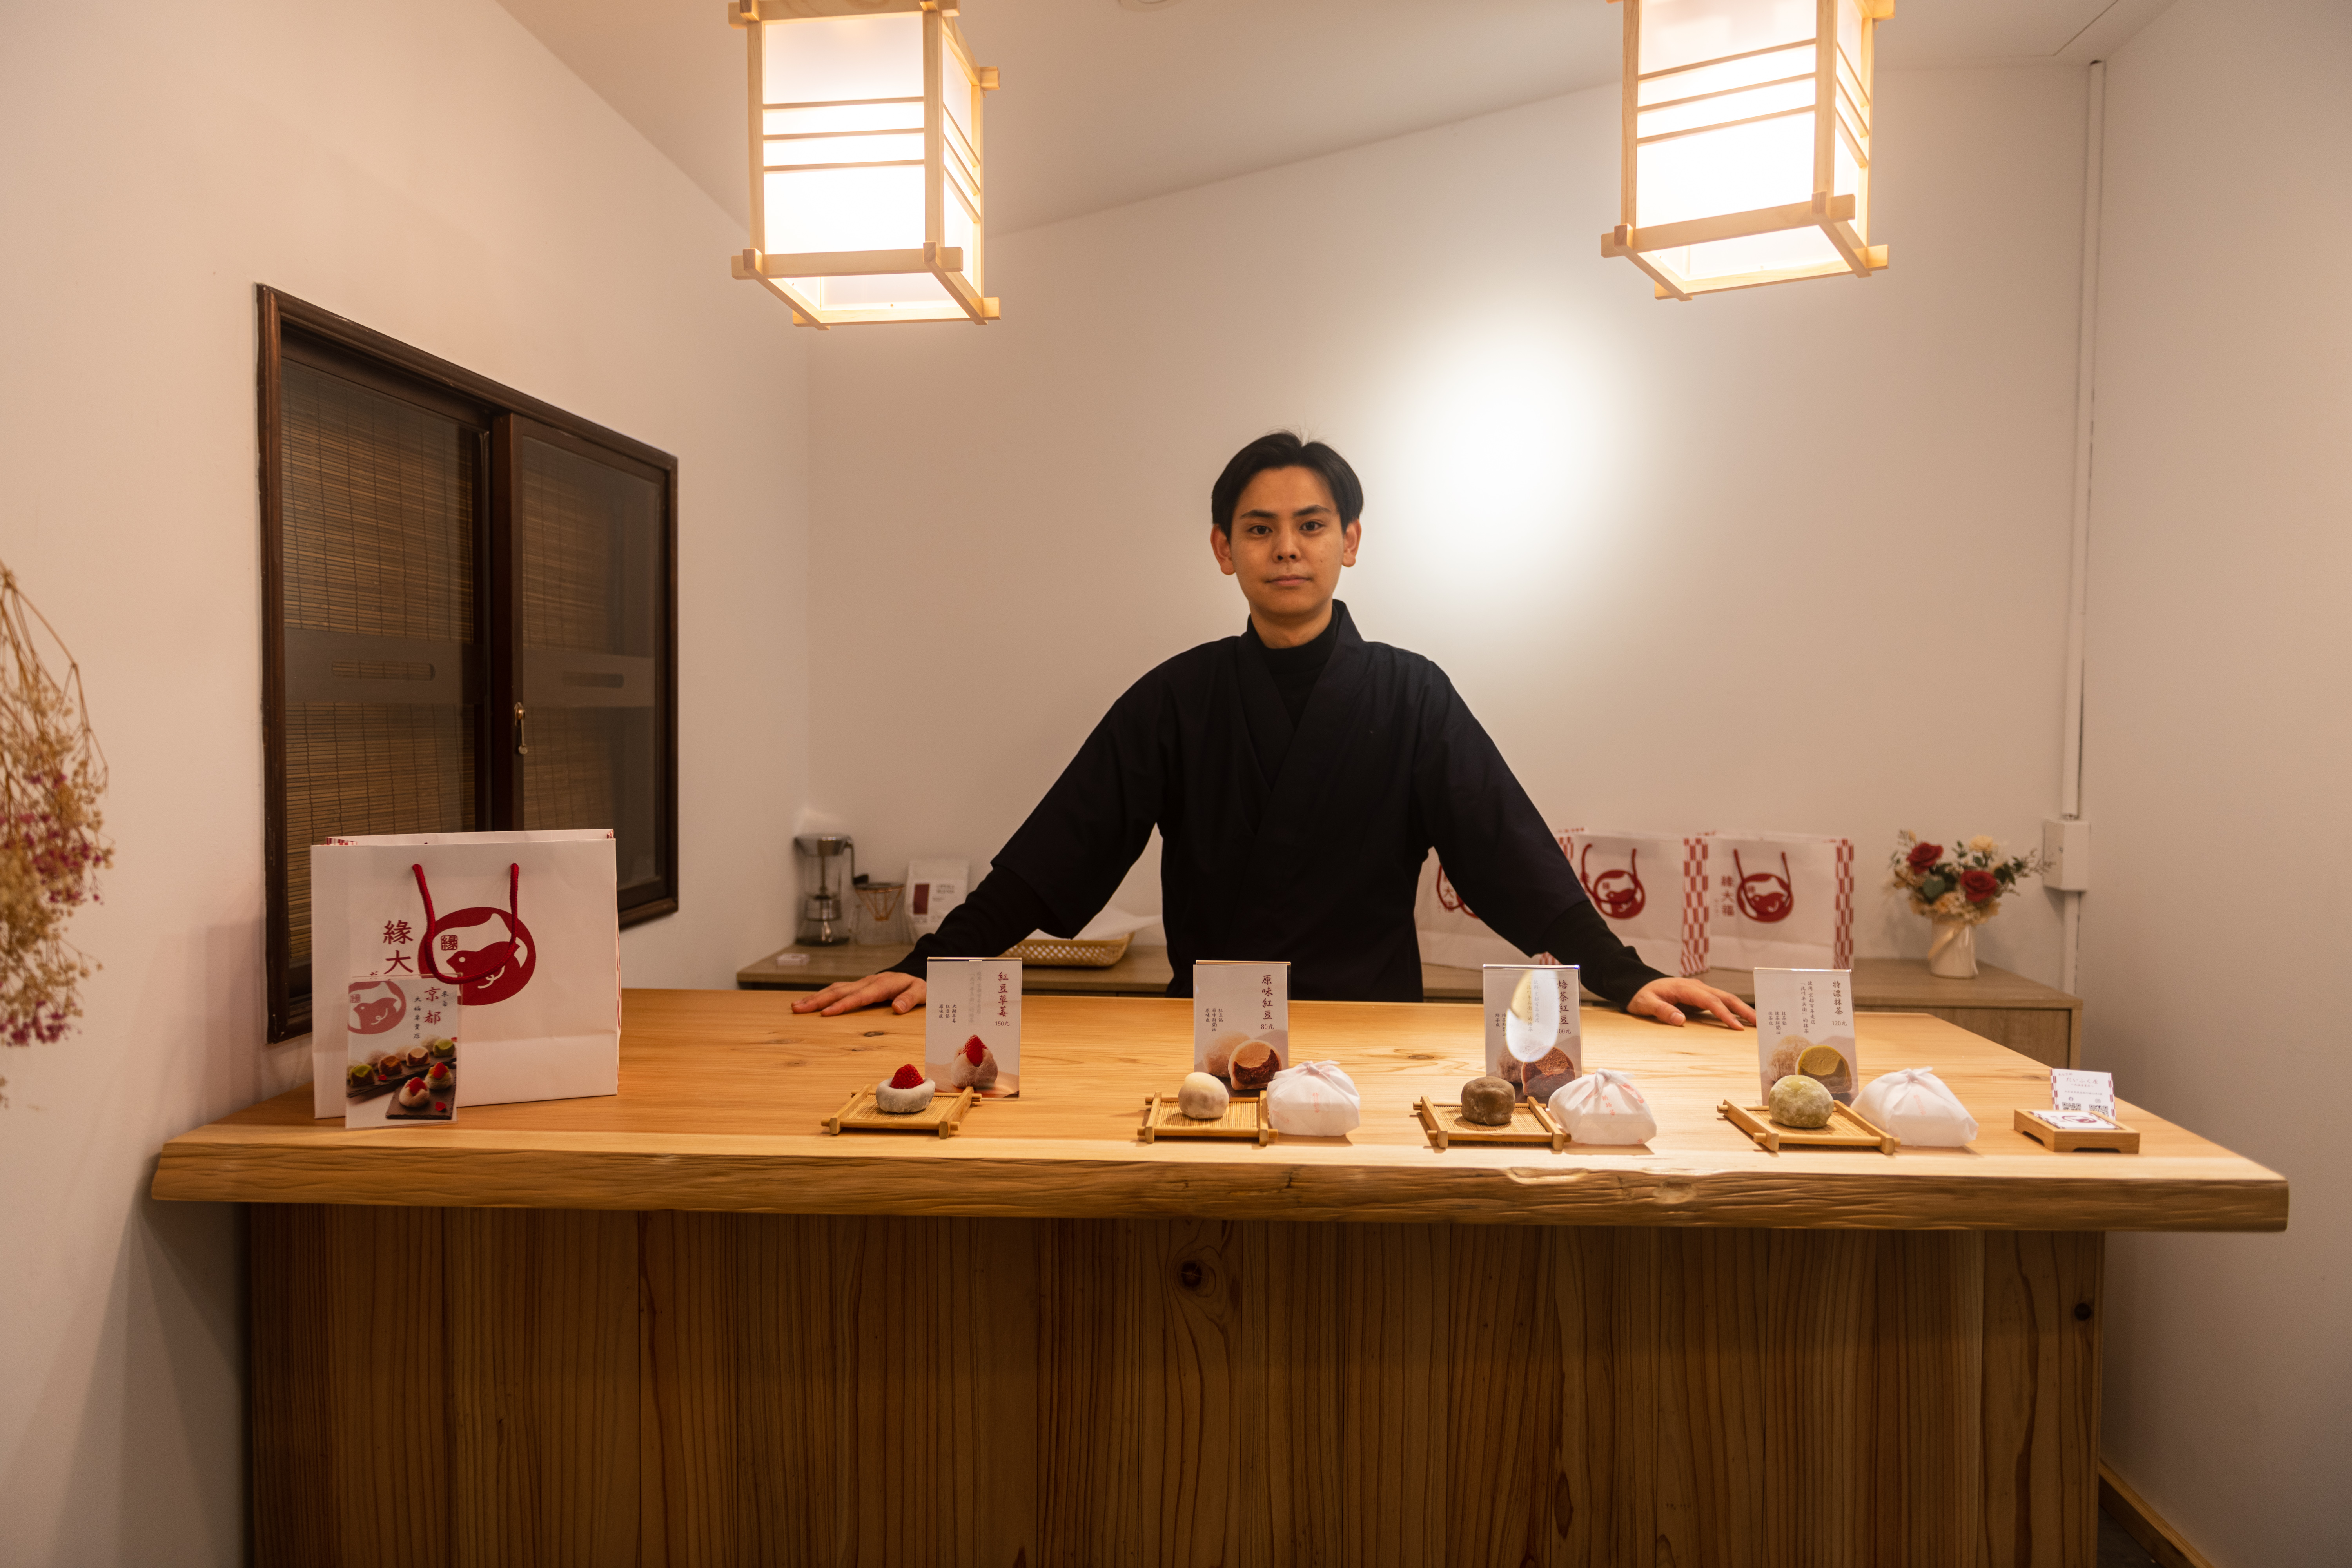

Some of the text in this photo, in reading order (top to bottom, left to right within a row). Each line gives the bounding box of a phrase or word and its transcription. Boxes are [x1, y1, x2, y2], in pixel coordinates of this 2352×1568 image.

[383, 920, 414, 975] 緣大
[423, 987, 441, 1025] 京都
[997, 972, 1009, 1017] 紅豆草莓
[1262, 975, 1273, 1020] 原味紅豆
[1557, 980, 1569, 1025] 焙茶紅豆
[1832, 980, 1843, 1015] 特濃抹茶
